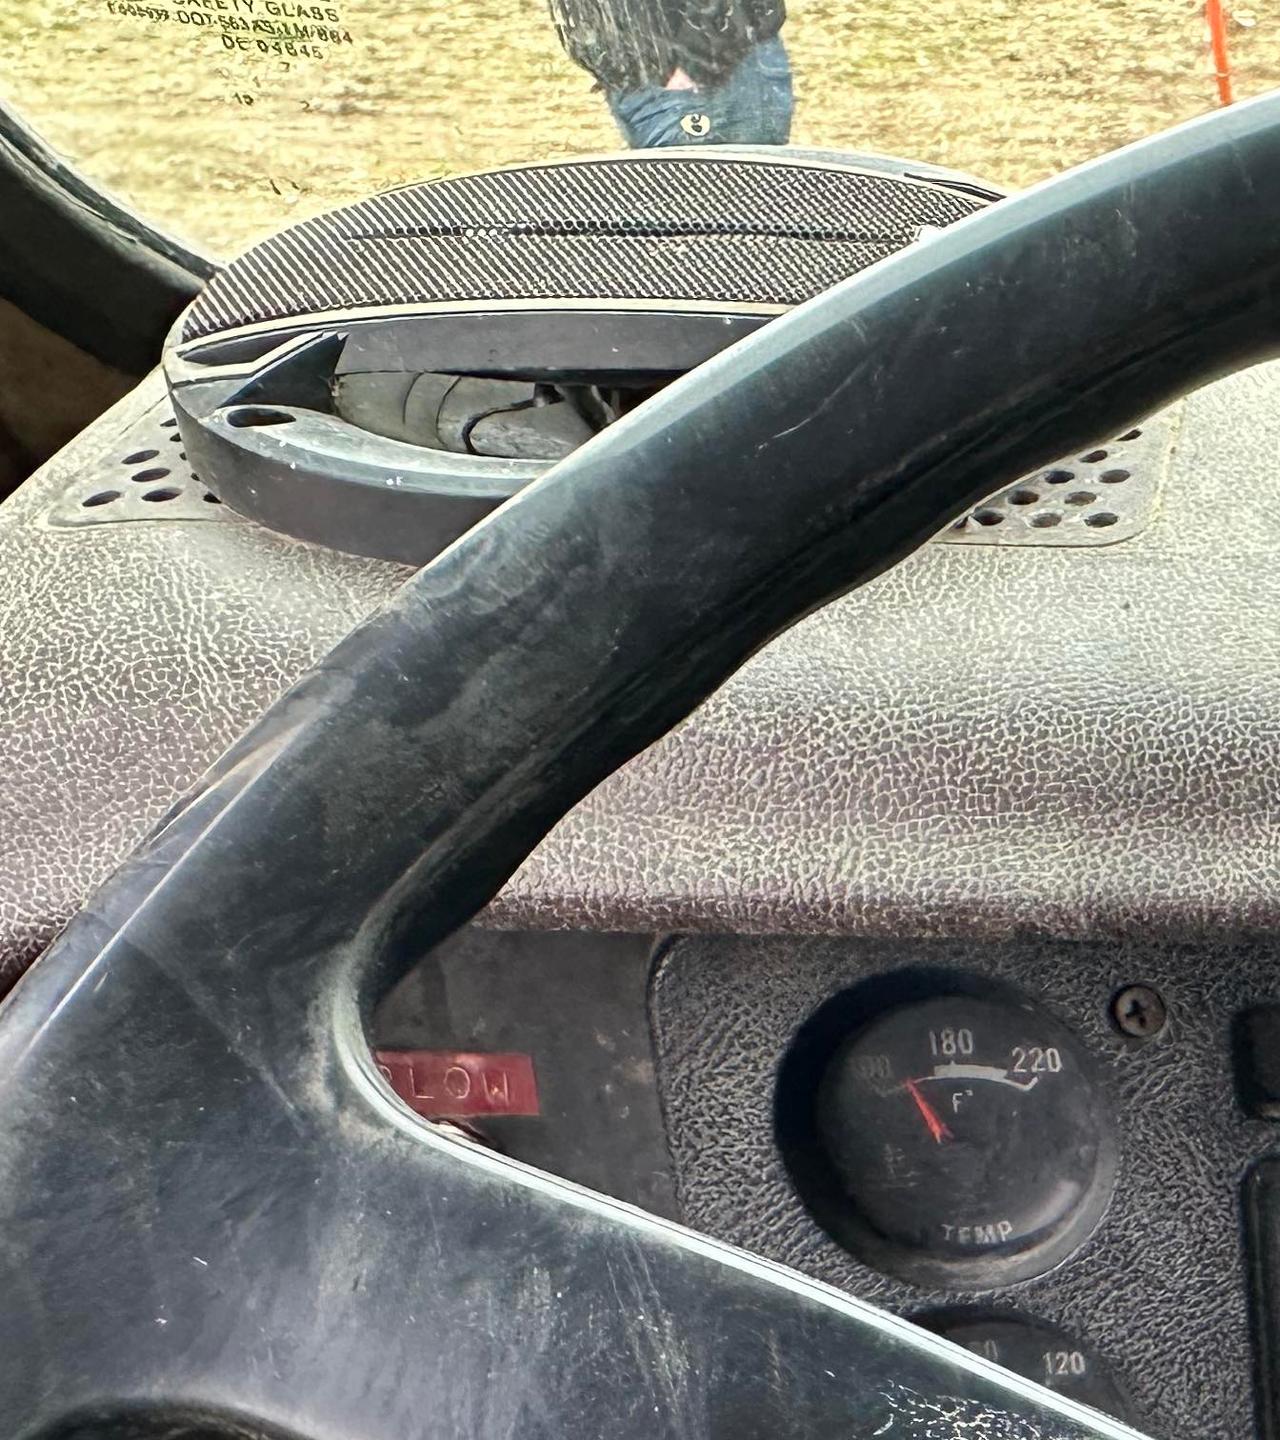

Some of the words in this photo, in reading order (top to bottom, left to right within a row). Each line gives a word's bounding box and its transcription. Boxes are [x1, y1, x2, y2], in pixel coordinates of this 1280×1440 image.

[264, 0, 339, 22] GLASS
[929, 1029, 974, 1055] 180
[1011, 1047, 1062, 1073] 220
[941, 1220, 1013, 1246] TEMP
[1042, 1350, 1086, 1376] 120
